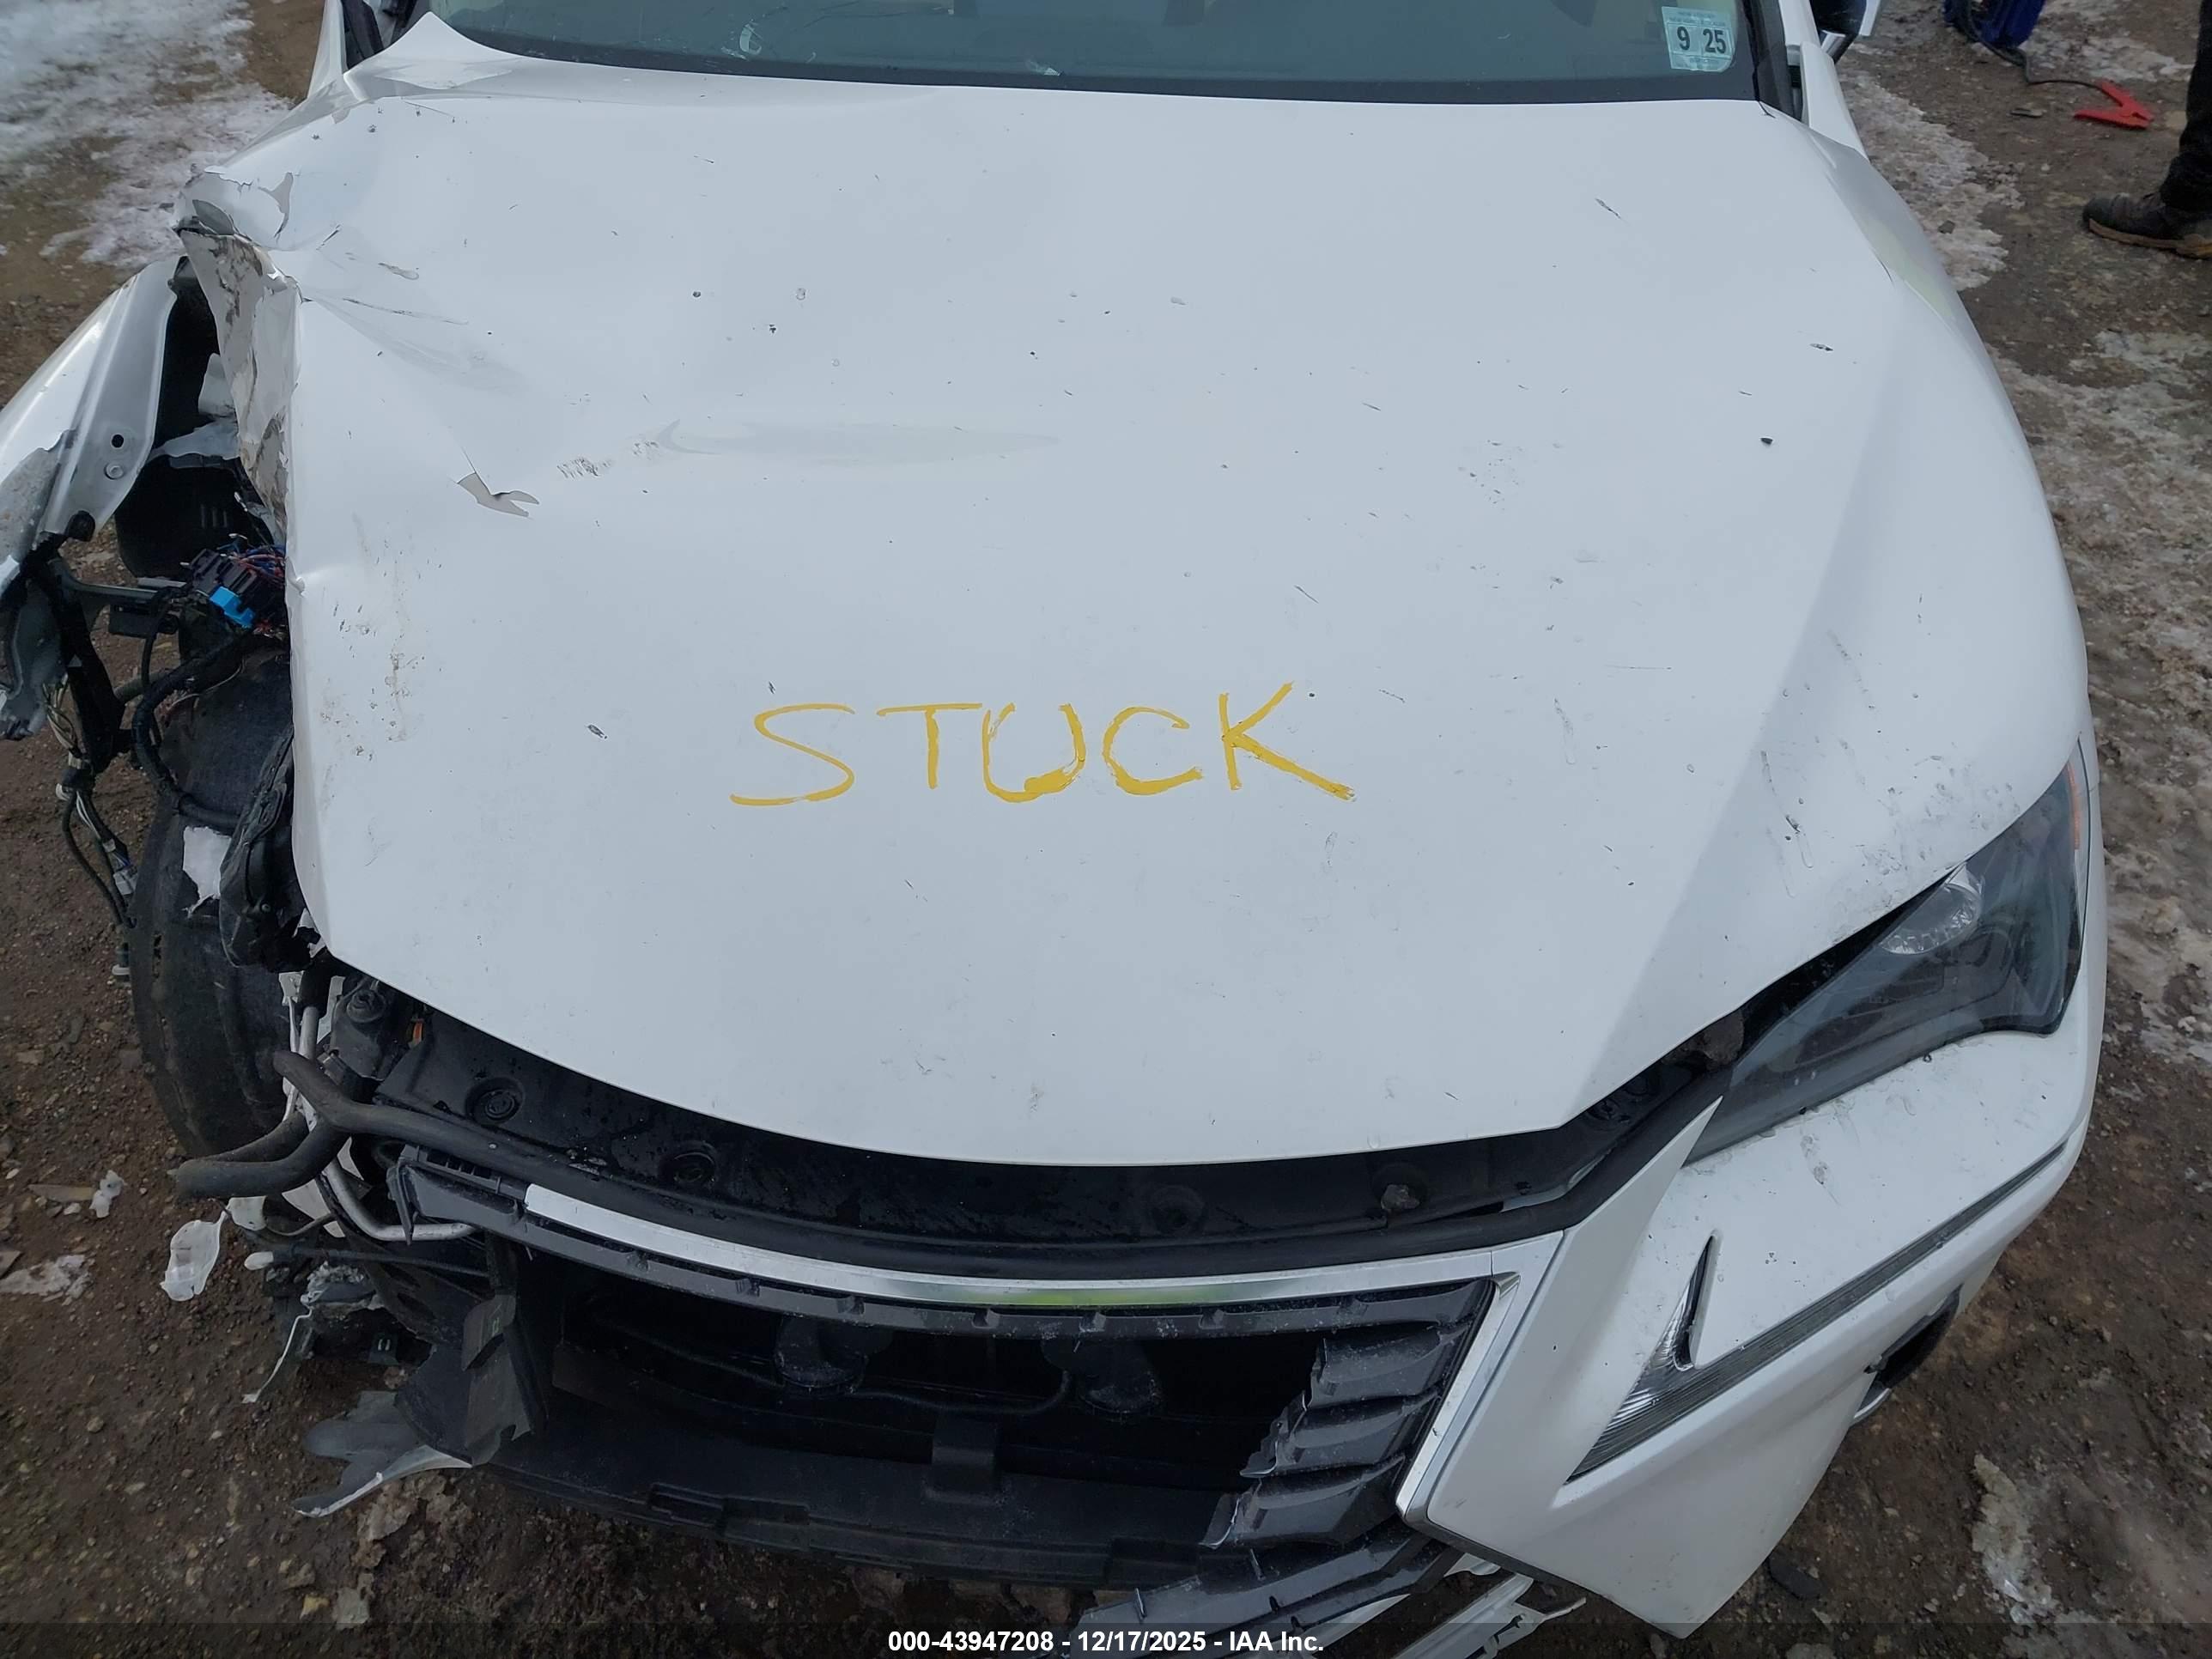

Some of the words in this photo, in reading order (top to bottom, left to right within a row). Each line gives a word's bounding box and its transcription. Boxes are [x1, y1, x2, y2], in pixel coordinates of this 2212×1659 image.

[1677, 26, 1691, 51] 9
[1703, 28, 1727, 54] 25
[730, 682, 1355, 807] STUCK
